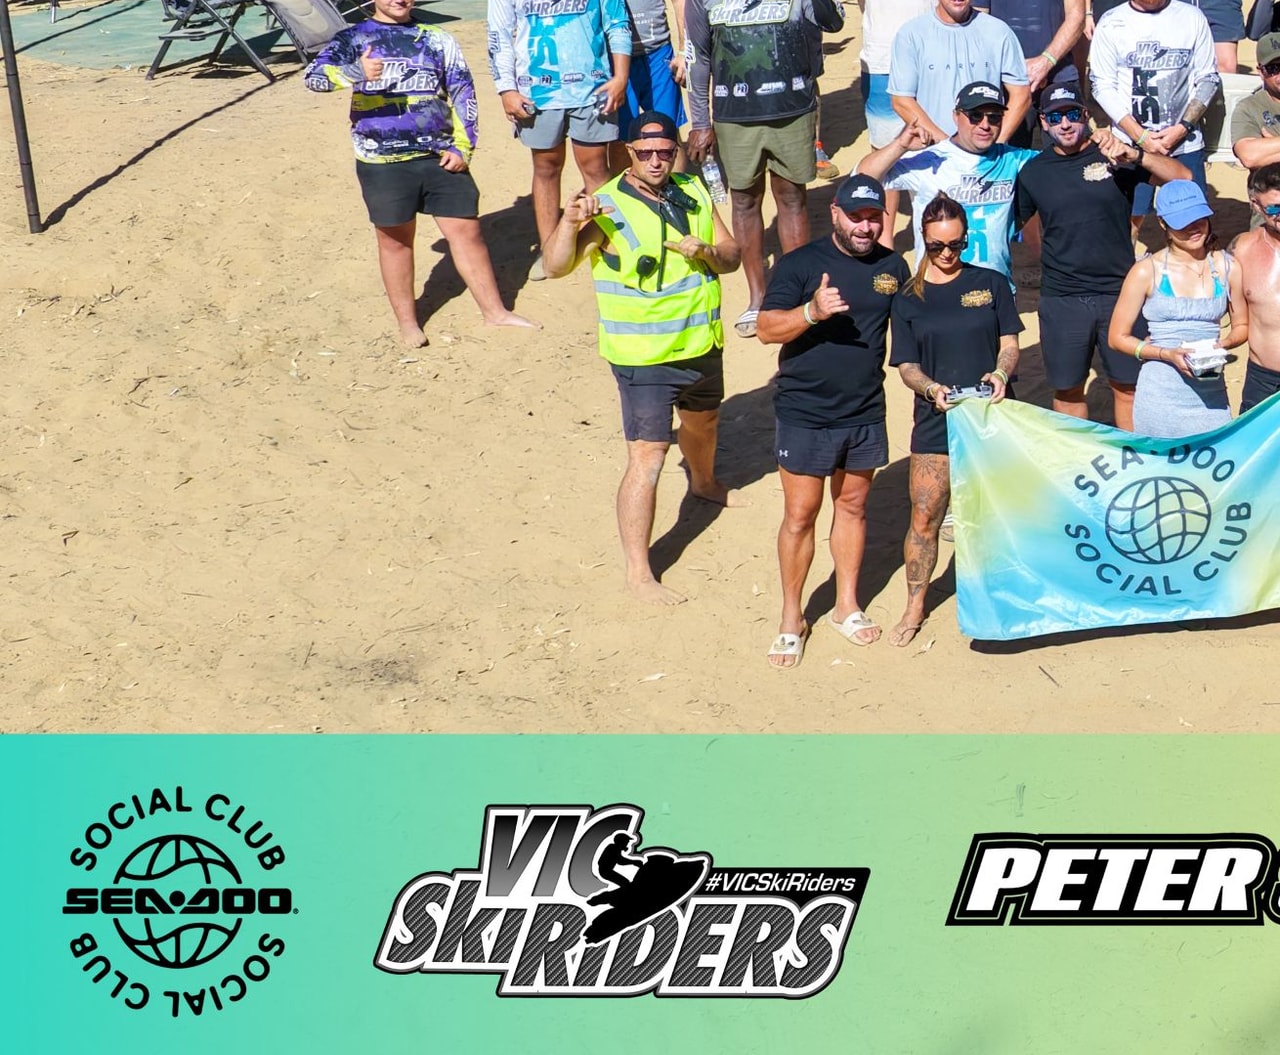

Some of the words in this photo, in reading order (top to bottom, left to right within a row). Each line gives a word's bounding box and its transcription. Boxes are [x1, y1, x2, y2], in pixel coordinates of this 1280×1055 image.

[928, 62, 991, 71] CARVE
[1064, 523, 1183, 597] SOCIAL
[1197, 500, 1253, 583] CLUB
